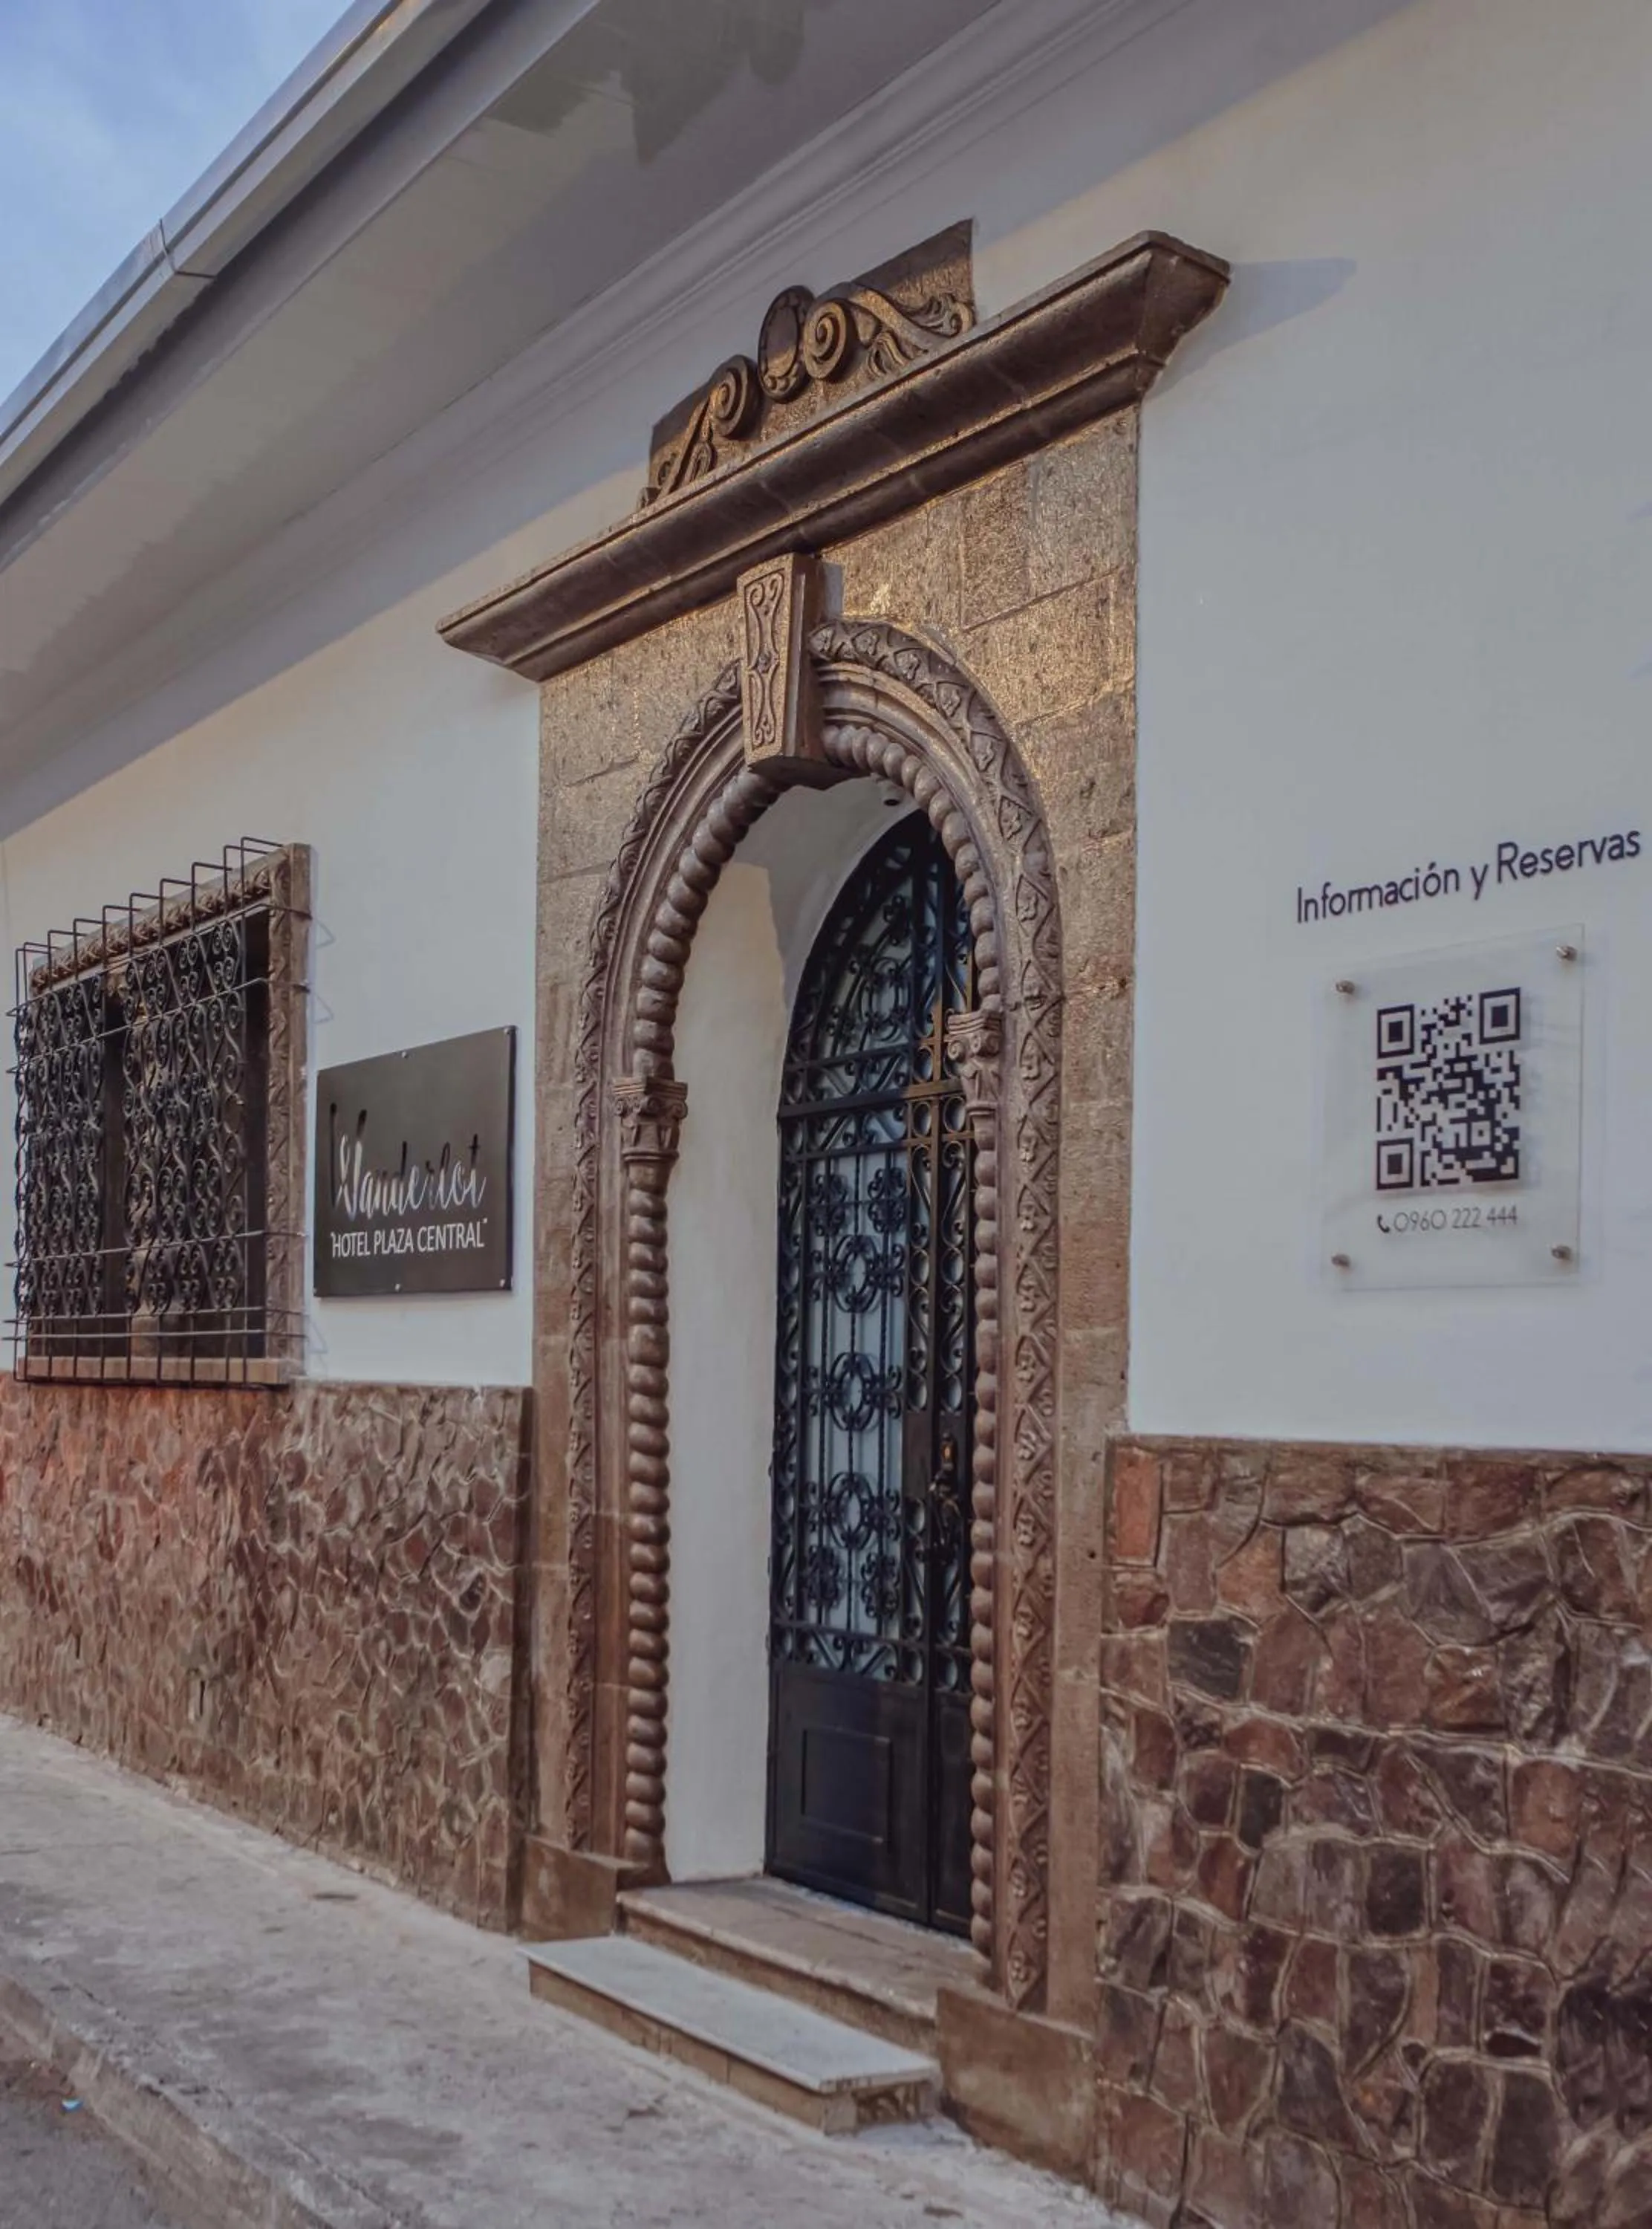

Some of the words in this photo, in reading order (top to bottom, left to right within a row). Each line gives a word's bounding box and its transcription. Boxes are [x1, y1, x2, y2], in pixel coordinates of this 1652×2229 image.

[1297, 862, 1460, 923] Información
[1470, 863, 1489, 901] y
[1497, 830, 1641, 883] Reservas
[1394, 1210, 1448, 1232] 0960
[1451, 1207, 1482, 1229] 222
[1486, 1204, 1518, 1226] 444
[374, 1228, 414, 1255] PLAZA
